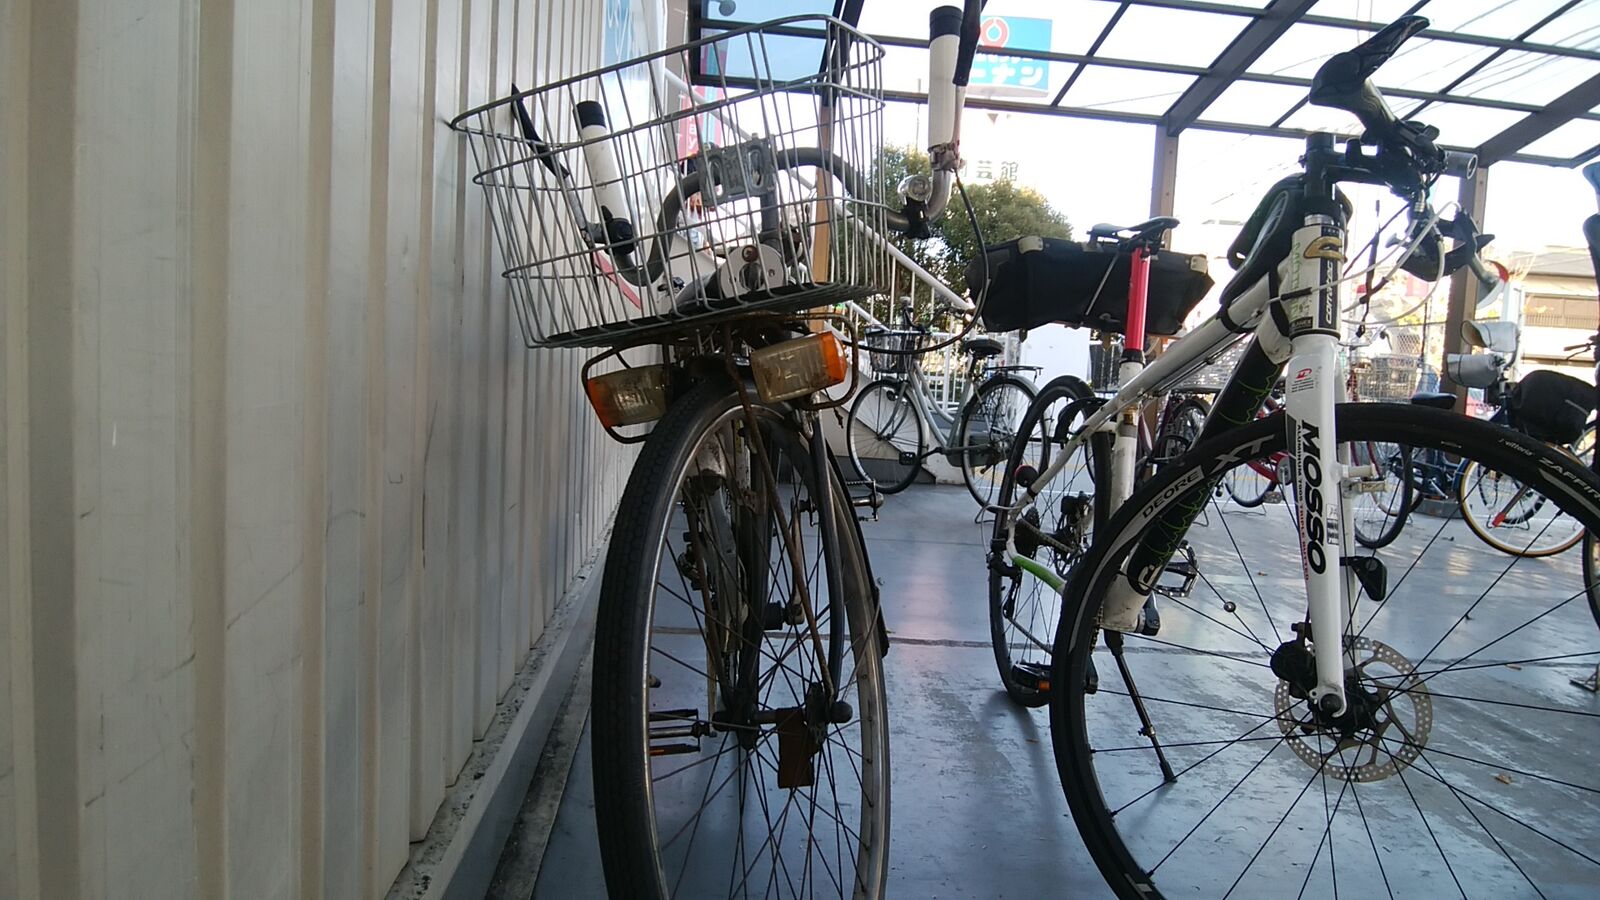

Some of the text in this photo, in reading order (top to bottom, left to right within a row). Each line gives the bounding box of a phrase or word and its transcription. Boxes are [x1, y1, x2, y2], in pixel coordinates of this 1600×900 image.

[971, 62, 1044, 86] ーナン
[1503, 441, 1534, 456] vittoria
[1142, 434, 1275, 519] DEORE XT
[1301, 420, 1326, 575] MOSSO
[1301, 541, 1310, 582] BUTTED
